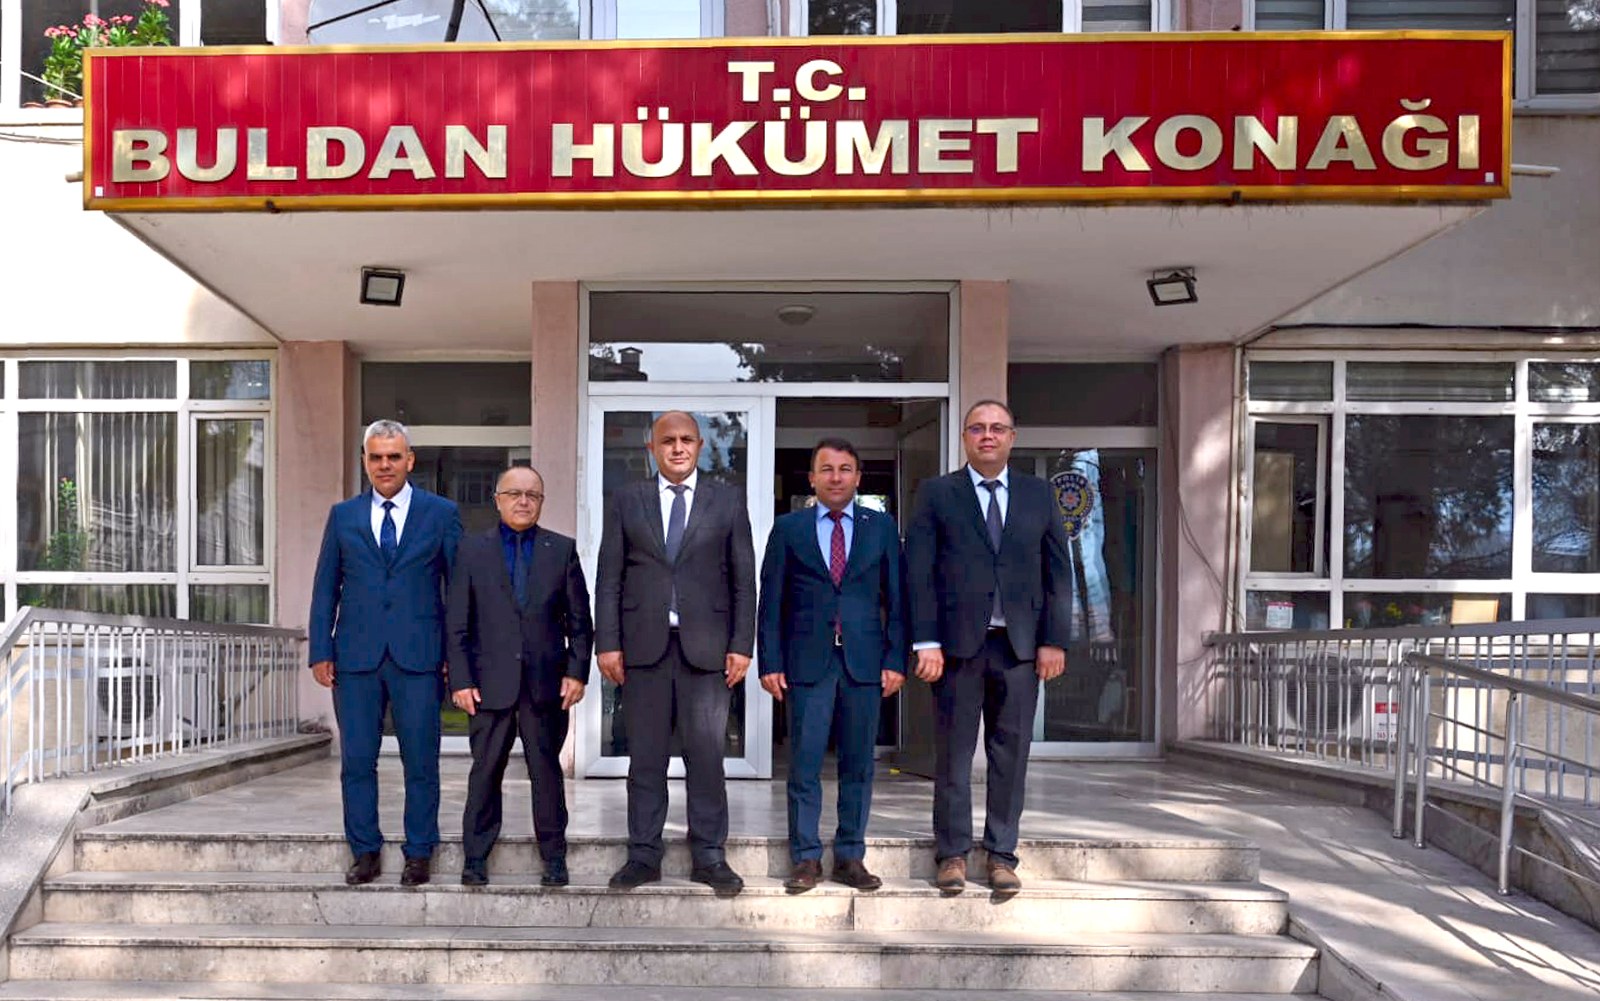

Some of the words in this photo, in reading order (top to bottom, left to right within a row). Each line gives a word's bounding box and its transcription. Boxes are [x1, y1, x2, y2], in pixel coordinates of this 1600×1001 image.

[727, 60, 867, 102] T.C.
[111, 125, 508, 183] BULDAN
[551, 106, 1039, 178] HÜKÜMET
[1081, 98, 1480, 171] KONAĞI
